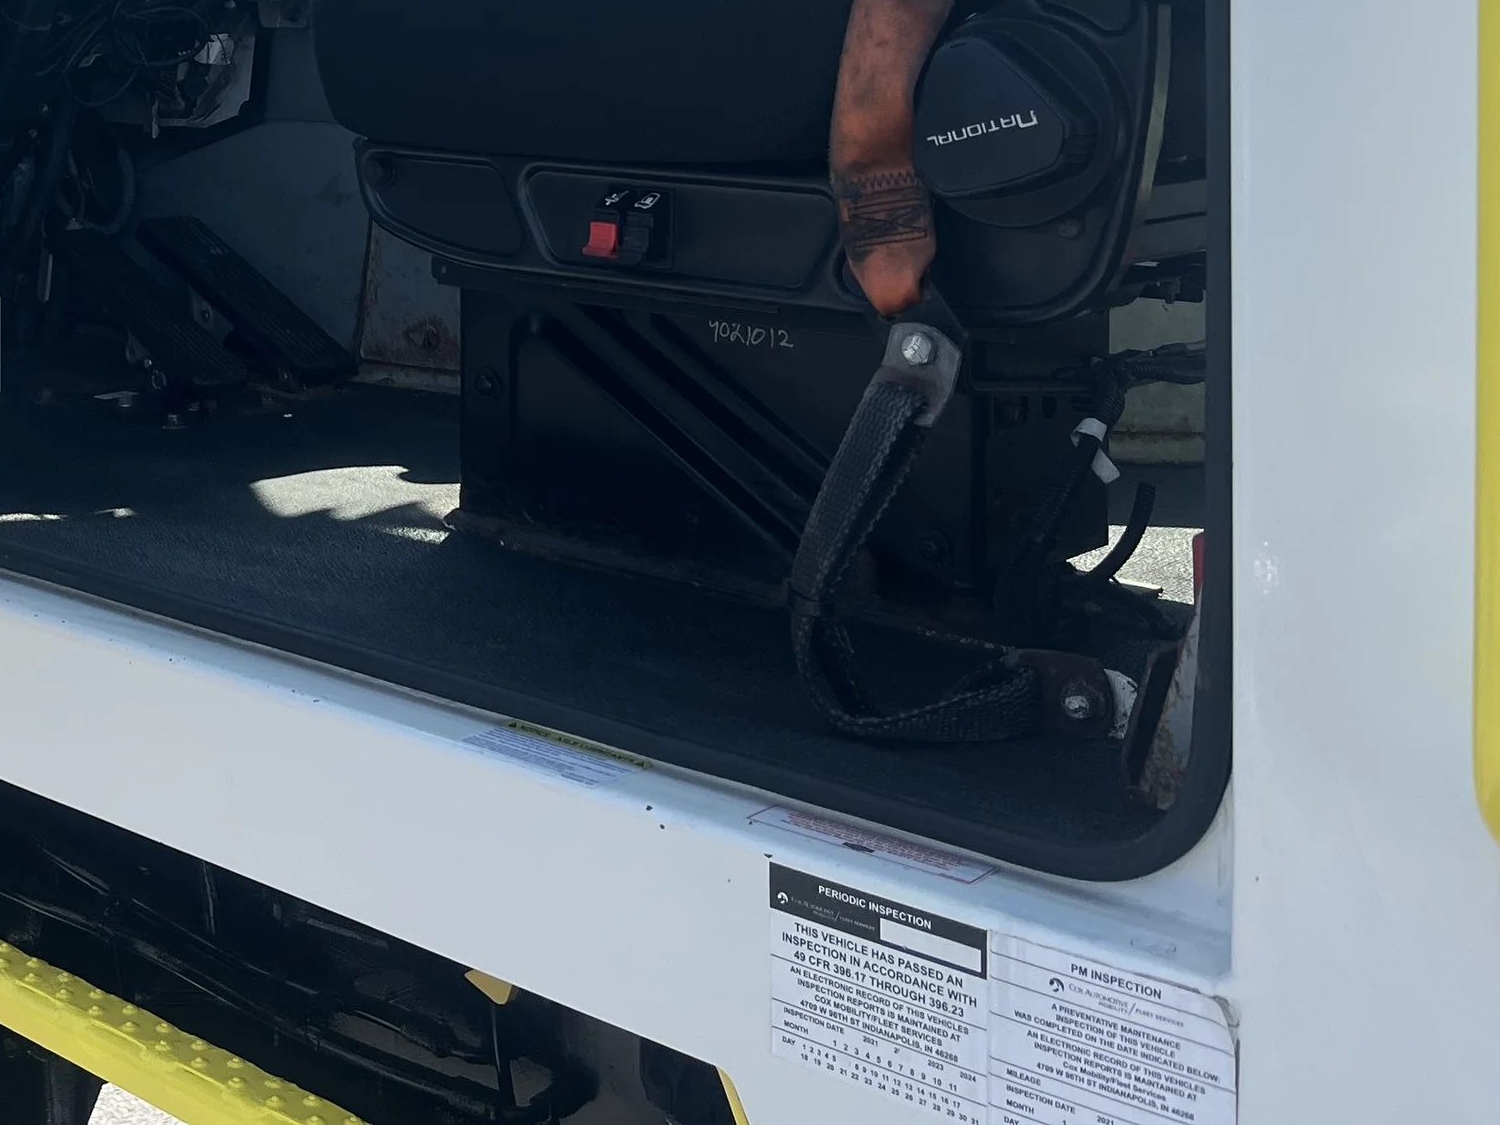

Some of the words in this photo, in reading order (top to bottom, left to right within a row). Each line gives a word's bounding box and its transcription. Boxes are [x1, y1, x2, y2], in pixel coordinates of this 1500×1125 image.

[927, 110, 1038, 146] NATIONAL
[819, 885, 866, 908] PERIODIC
[869, 901, 932, 930] INSPECTION
[782, 932, 847, 963] INSPECTION
[850, 954, 861, 967] IN
[863, 960, 945, 996] ACCORDANCE
[948, 988, 977, 1008] WITH
[794, 923, 819, 939] THIS
[821, 931, 868, 955] VEHICLE
[872, 948, 895, 965] HAS
[898, 957, 944, 981] PASSED
[946, 974, 963, 988] AN
[1071, 963, 1088, 978] PM
[1091, 969, 1162, 1000] INSPECTION
[790, 966, 801, 976] AN
[803, 969, 854, 994] ELECTRONIC
[856, 989, 890, 1007] RECORD
[892, 1002, 904, 1012] OF
[906, 1007, 925, 1019] THIS
[927, 1013, 969, 1035] VEHICLES
[794, 952, 806, 964] 49
[808, 957, 830, 971] CFR
[833, 964, 865, 983] 396.17
[869, 976, 926, 1005] THROUGH
[929, 997, 964, 1017] 396.23
[798, 979, 845, 1004] INSPECTION
[847, 995, 885, 1016] REPORTS
[888, 1009, 895, 1018] IS
[898, 1014, 948, 1038] MAINTAINED
[950, 1033, 961, 1043] AT
[783, 1007, 825, 1029] INSPECTION
[826, 1022, 845, 1034] DATE
[862, 1035, 879, 1047] 2021
[927, 1059, 944, 1071] 2023
[959, 1071, 977, 1083] 2024
[800, 1000, 817, 1012] 4709
[819, 1007, 828, 1016] W
[829, 1010, 848, 1023] 96TH
[850, 1017, 860, 1027] ST
[924, 1043, 933, 1053] IN
[814, 995, 831, 1007] COX
[833, 1001, 899, 1031] MOBILITY/FLEET
[901, 1025, 943, 1047] SERVICES
[1014, 1010, 1032, 1022] WAS
[1034, 1016, 1083, 1038] COMPLETED
[1085, 1033, 1098, 1043] ON
[1100, 1037, 1115, 1049] THE
[1117, 1043, 1139, 1057] DATE
[1141, 1051, 1184, 1071] INDICATED
[1051, 1003, 1058, 1011] A
[1059, 1004, 1119, 1031] PREVENTATIVE
[1121, 1023, 1181, 1050] MAINTENANCE
[1056, 1014, 1104, 1036] INSPECTION
[1107, 1030, 1117, 1039] OF
[1119, 1034, 1138, 1046] THIS
[1140, 1041, 1176, 1058] VEHICLE
[782, 1035, 796, 1047] DAY
[817, 1048, 822, 1056] 3
[832, 1054, 837, 1062] 5
[854, 1063, 859, 1071] 8
[870, 1069, 879, 1077] 10
[882, 1074, 890, 1082] 11
[893, 1078, 901, 1086] 12
[905, 1082, 913, 1091] 13
[917, 1087, 925, 1095] 14
[929, 1091, 937, 1100] 15
[940, 1096, 949, 1104] 16
[952, 1100, 961, 1109] 17
[783, 1020, 809, 1035] MONTH
[854, 1047, 859, 1055] 3
[865, 1052, 871, 1060] 4
[876, 1056, 882, 1064] 5
[887, 1060, 893, 1068] 6
[898, 1064, 904, 1072] 7
[910, 1068, 915, 1076] 8
[921, 1072, 926, 1081] 9
[932, 1076, 942, 1086] 10
[948, 1083, 957, 1092] 11
[1007, 1068, 1041, 1086] MILEAGE
[1027, 1030, 1038, 1039] AN
[1040, 1033, 1091, 1056] ELECTRONIC
[1093, 1051, 1128, 1068] RECORD
[1130, 1062, 1141, 1072] OF
[1144, 1068, 1161, 1080] THIS
[1164, 1074, 1205, 1094] VEHICLES
[1034, 1042, 1082, 1064] INSPECTION
[1084, 1057, 1122, 1077] REPORTS
[1125, 1071, 1132, 1080] IS
[1134, 1074, 1185, 1097] MAINTAINED
[1187, 1092, 1197, 1101] AT
[1063, 1061, 1077, 1072] Cox
[1133, 1084, 1166, 1101] Services
[800, 1053, 809, 1061] 18
[814, 1057, 822, 1066] 19
[826, 1062, 835, 1071] 20
[839, 1068, 848, 1076] 21
[851, 1072, 859, 1081] 22
[864, 1077, 873, 1086] 23
[877, 1082, 886, 1091] 24
[891, 1087, 900, 1096] 25
[905, 1092, 914, 1101] 26
[919, 1098, 927, 1106] 27
[932, 1103, 941, 1112] 28
[946, 1108, 955, 1118] 29
[959, 1113, 968, 1122] 30
[1006, 1084, 1053, 1106] INSPECTION
[1055, 1102, 1076, 1114] DATE
[1097, 1115, 1114, 1125] 2021
[1006, 1099, 1034, 1114] MONTH
[1056, 1068, 1063, 1076] W
[1087, 1079, 1096, 1088] ST
[1161, 1104, 1169, 1113] IN
[1004, 1116, 1019, 1125] DAY
